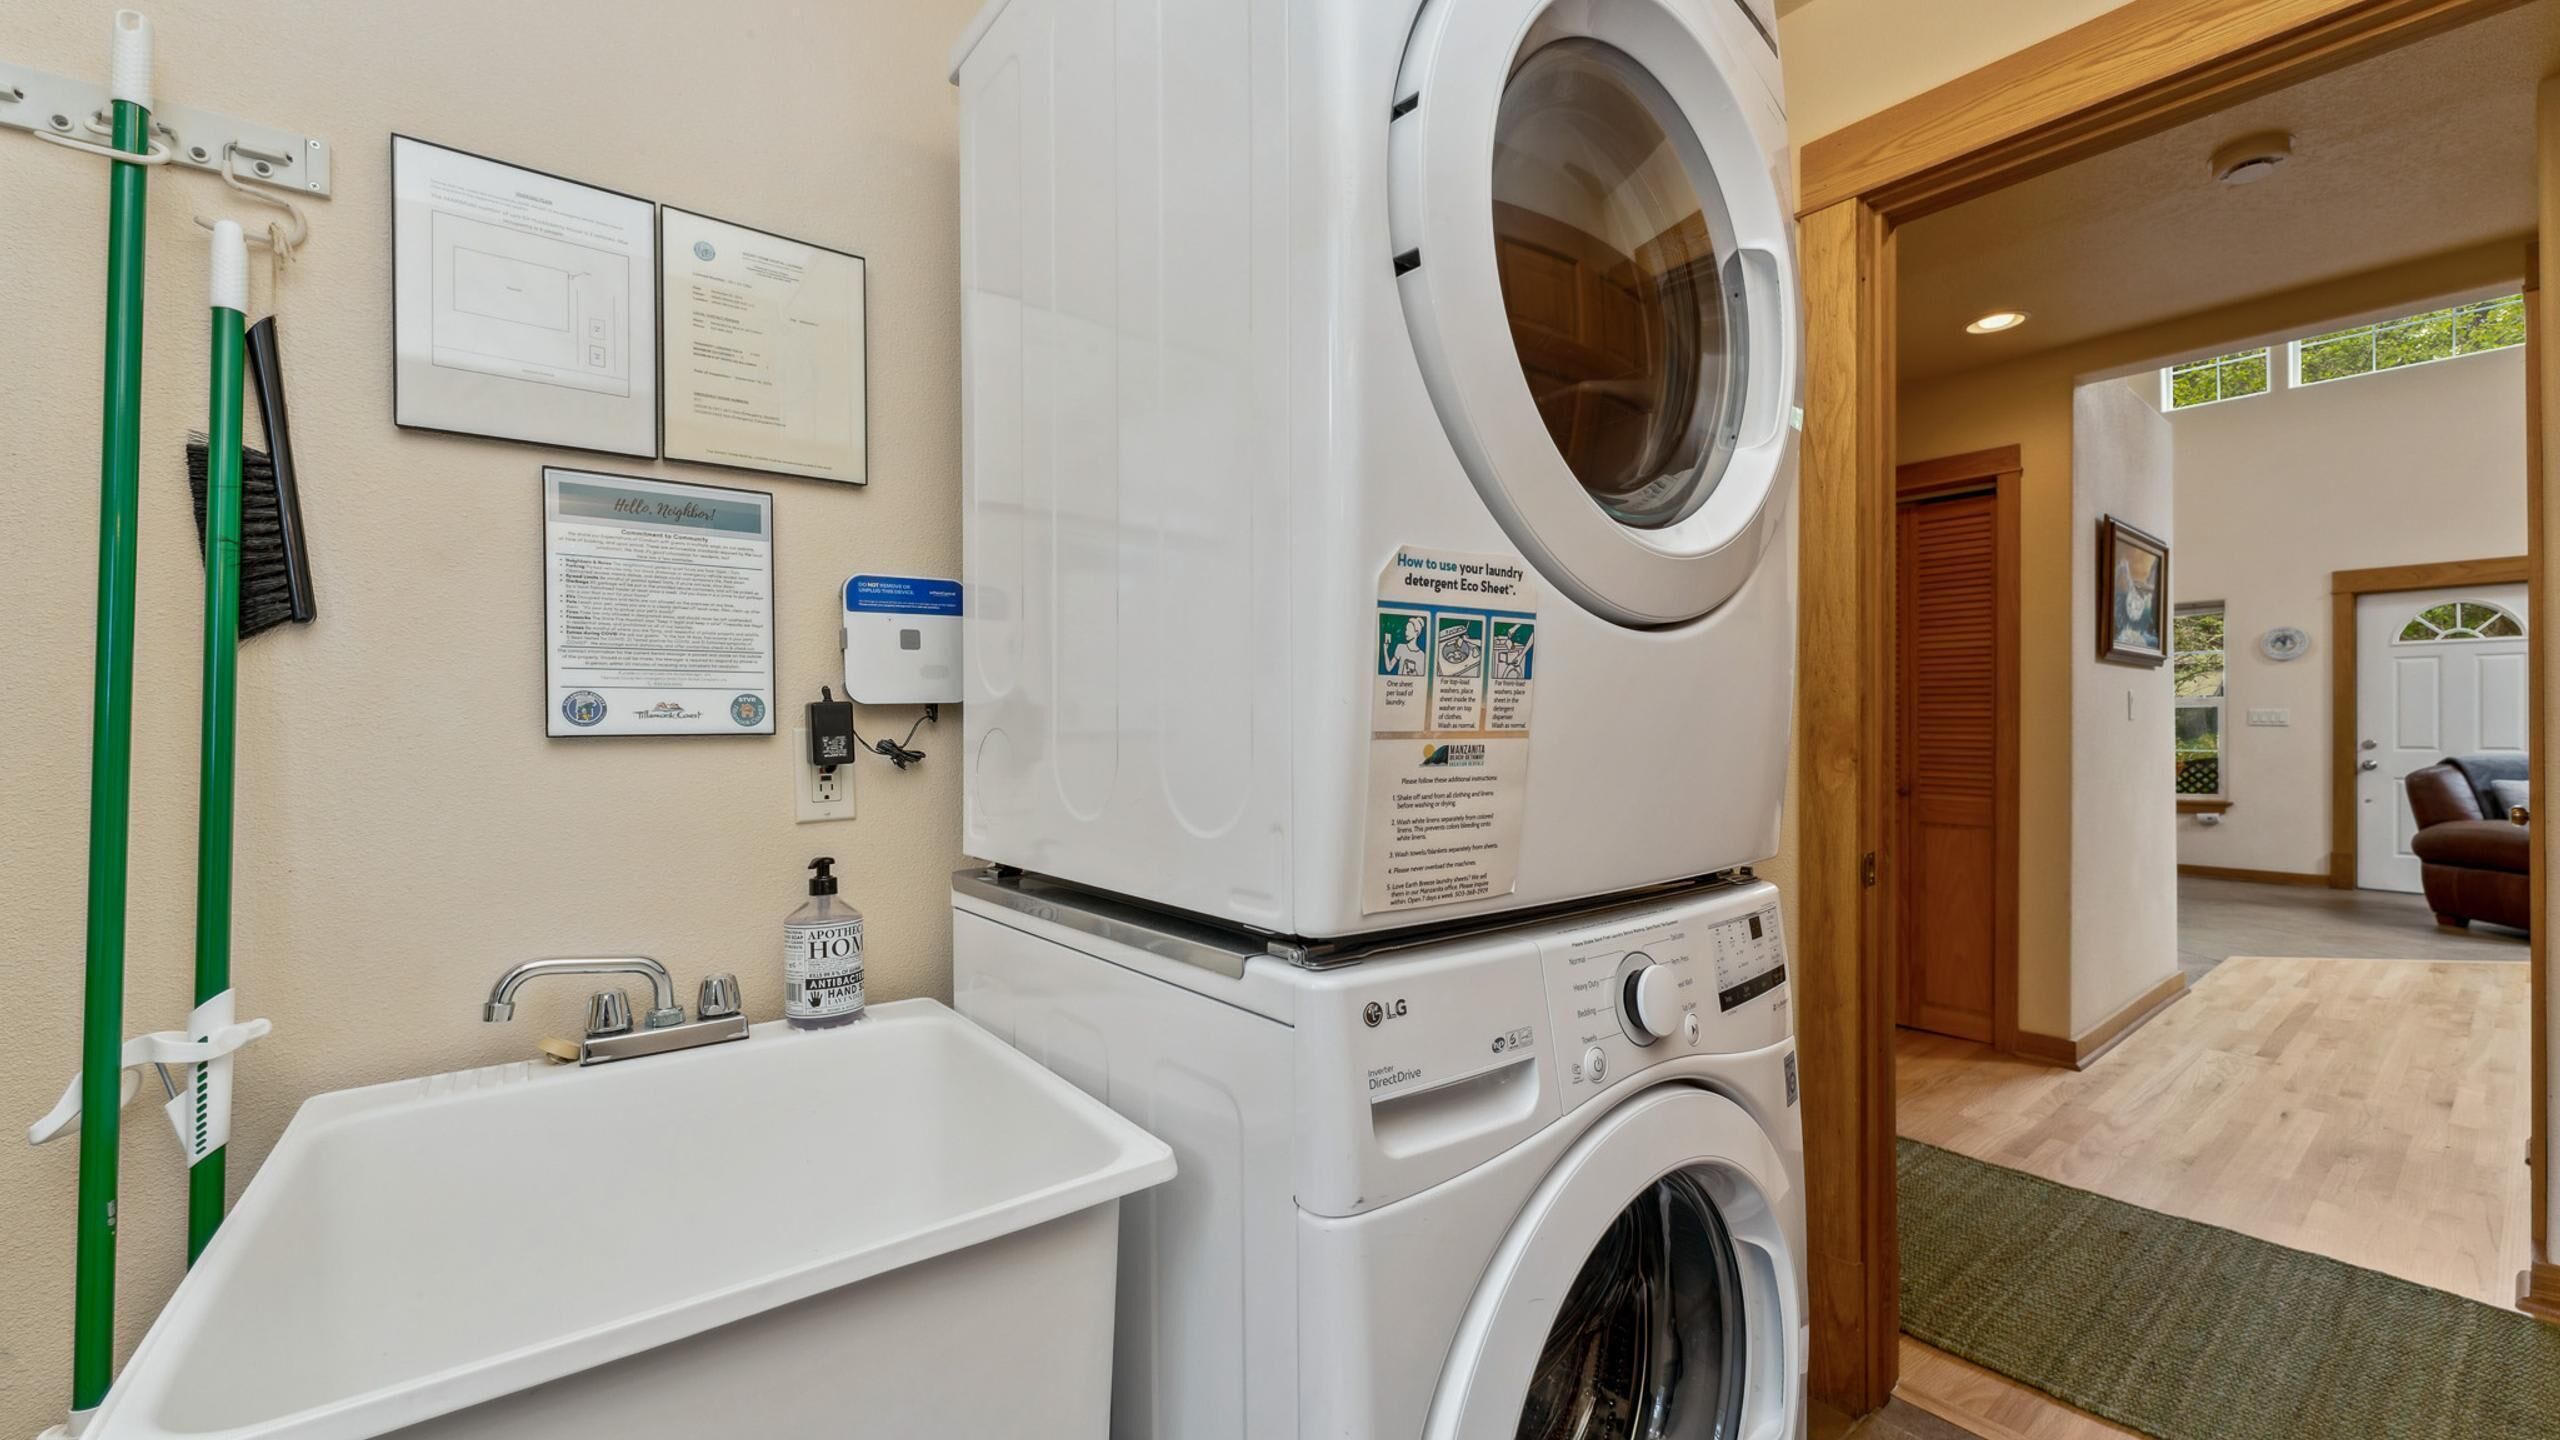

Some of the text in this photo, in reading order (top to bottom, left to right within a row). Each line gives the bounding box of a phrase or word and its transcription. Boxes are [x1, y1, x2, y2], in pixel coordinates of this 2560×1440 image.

[614, 498, 716, 522] Hello, Neighbor!
[621, 529, 663, 539] Commitment
[673, 533, 708, 543] Community
[1397, 553, 1523, 581] How to use your laundry
[1404, 573, 1458, 593] detergent
[1461, 578, 1478, 592] Eco
[636, 711, 702, 720] Tillamook Coast
[1450, 744, 1485, 754] MANZANITA
[1436, 878, 1452, 886] laundry
[1420, 887, 1444, 895] Manzanita
[1426, 894, 1437, 902] days
[808, 924, 864, 940] APOTHEC
[1568, 956, 1586, 965] Normal
[1573, 980, 1599, 991] Heavy Duty
[828, 985, 857, 998] HAND
[1386, 999, 1407, 1019] LG
[1577, 1008, 1596, 1018] Bedding
[1582, 1035, 1597, 1043] Towels
[1368, 1065, 1394, 1077] Inverter
